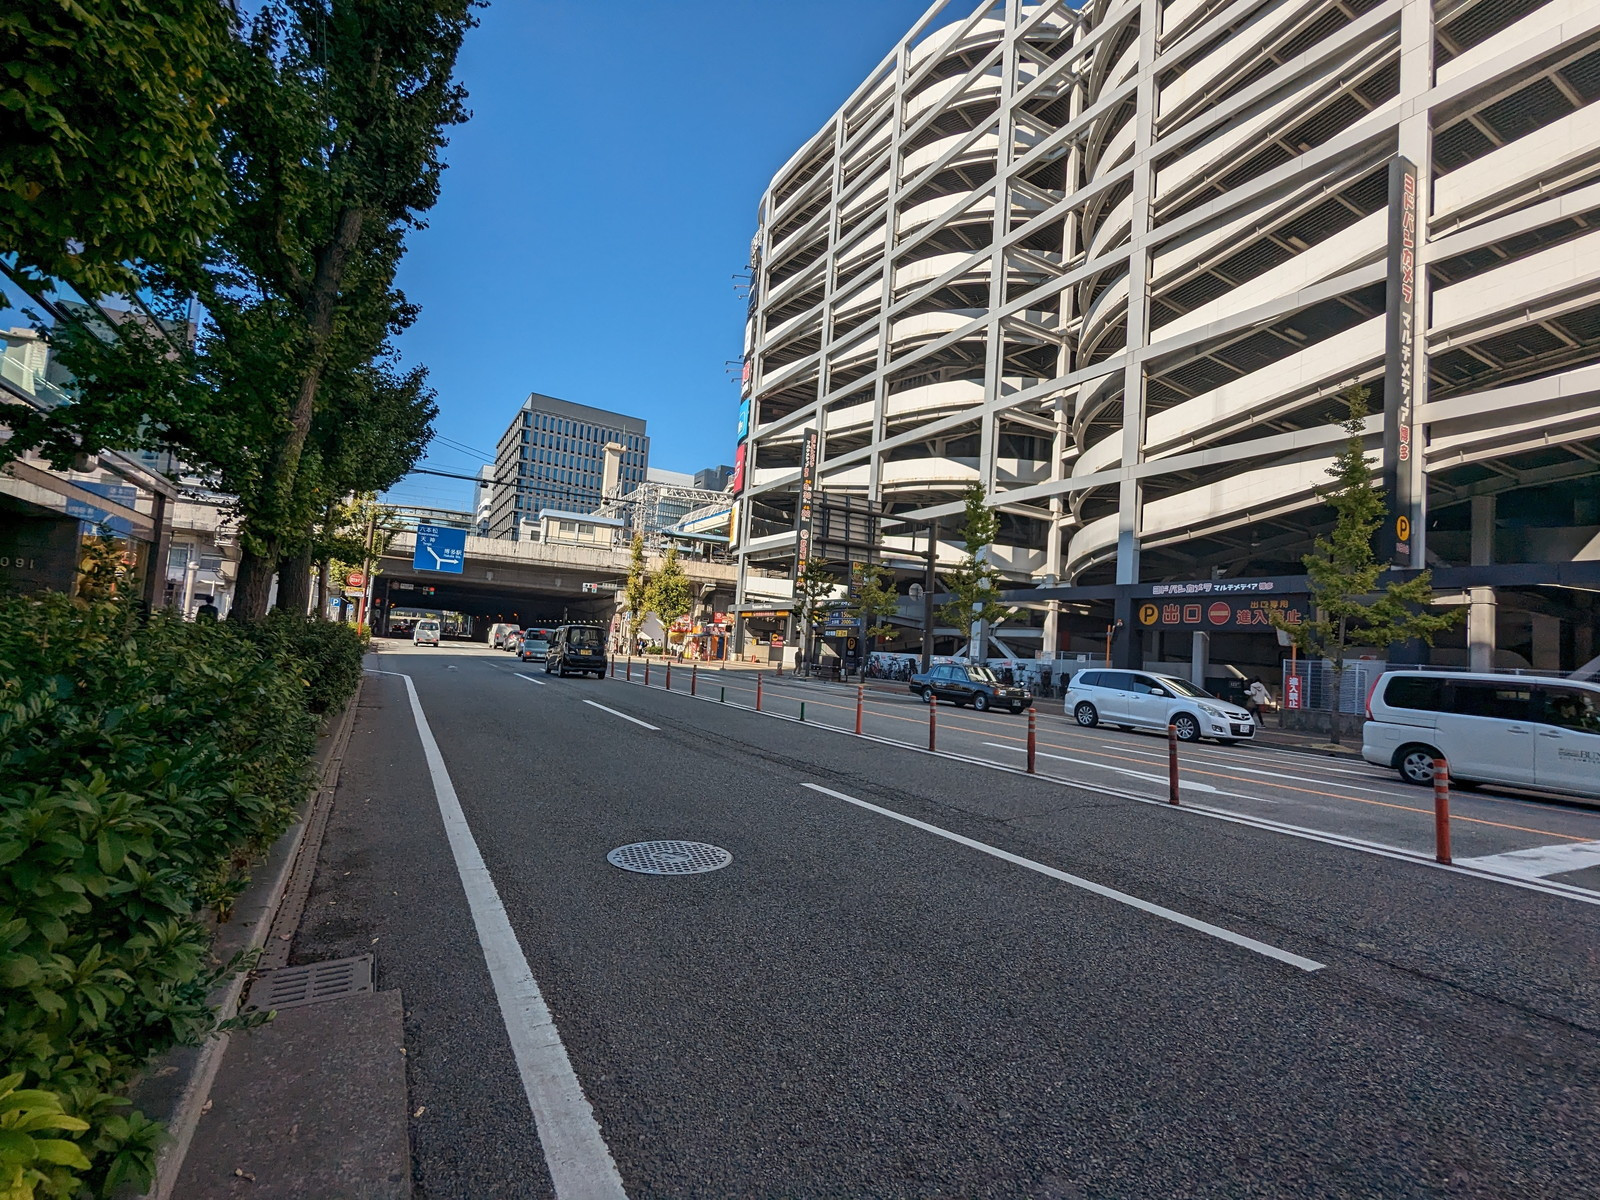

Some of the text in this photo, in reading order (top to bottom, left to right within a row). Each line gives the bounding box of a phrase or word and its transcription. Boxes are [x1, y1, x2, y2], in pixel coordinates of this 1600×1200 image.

[1402, 172, 1415, 304] ヨドバシカメラ
[1401, 311, 1412, 422] マルチメディア
[419, 526, 439, 534] 六本松
[1153, 583, 1212, 595] ヨドバシカメラ
[1213, 583, 1258, 591] マルチメディア
[1162, 604, 1202, 624] 出口
